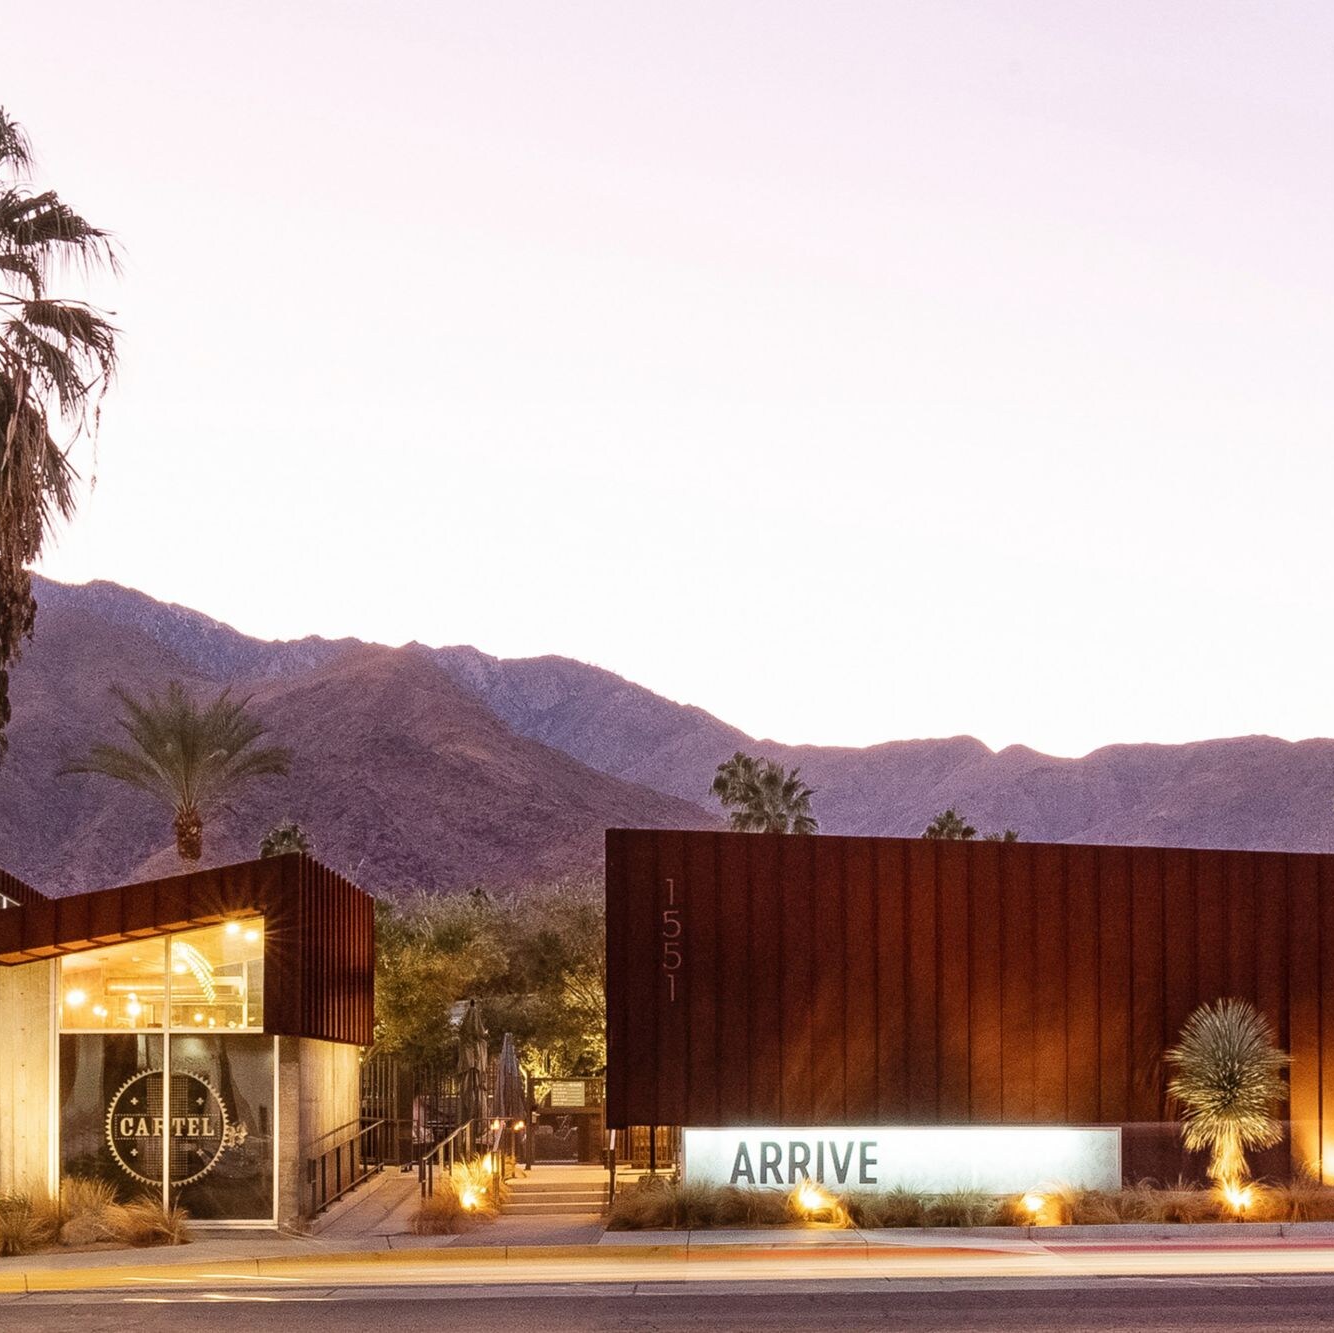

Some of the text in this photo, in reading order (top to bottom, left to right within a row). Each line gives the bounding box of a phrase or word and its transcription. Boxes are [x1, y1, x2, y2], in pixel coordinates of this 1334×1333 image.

[662, 878, 682, 1002] 1551
[120, 1117, 215, 1137] CARTEL
[729, 1140, 878, 1185] ARRIVE
